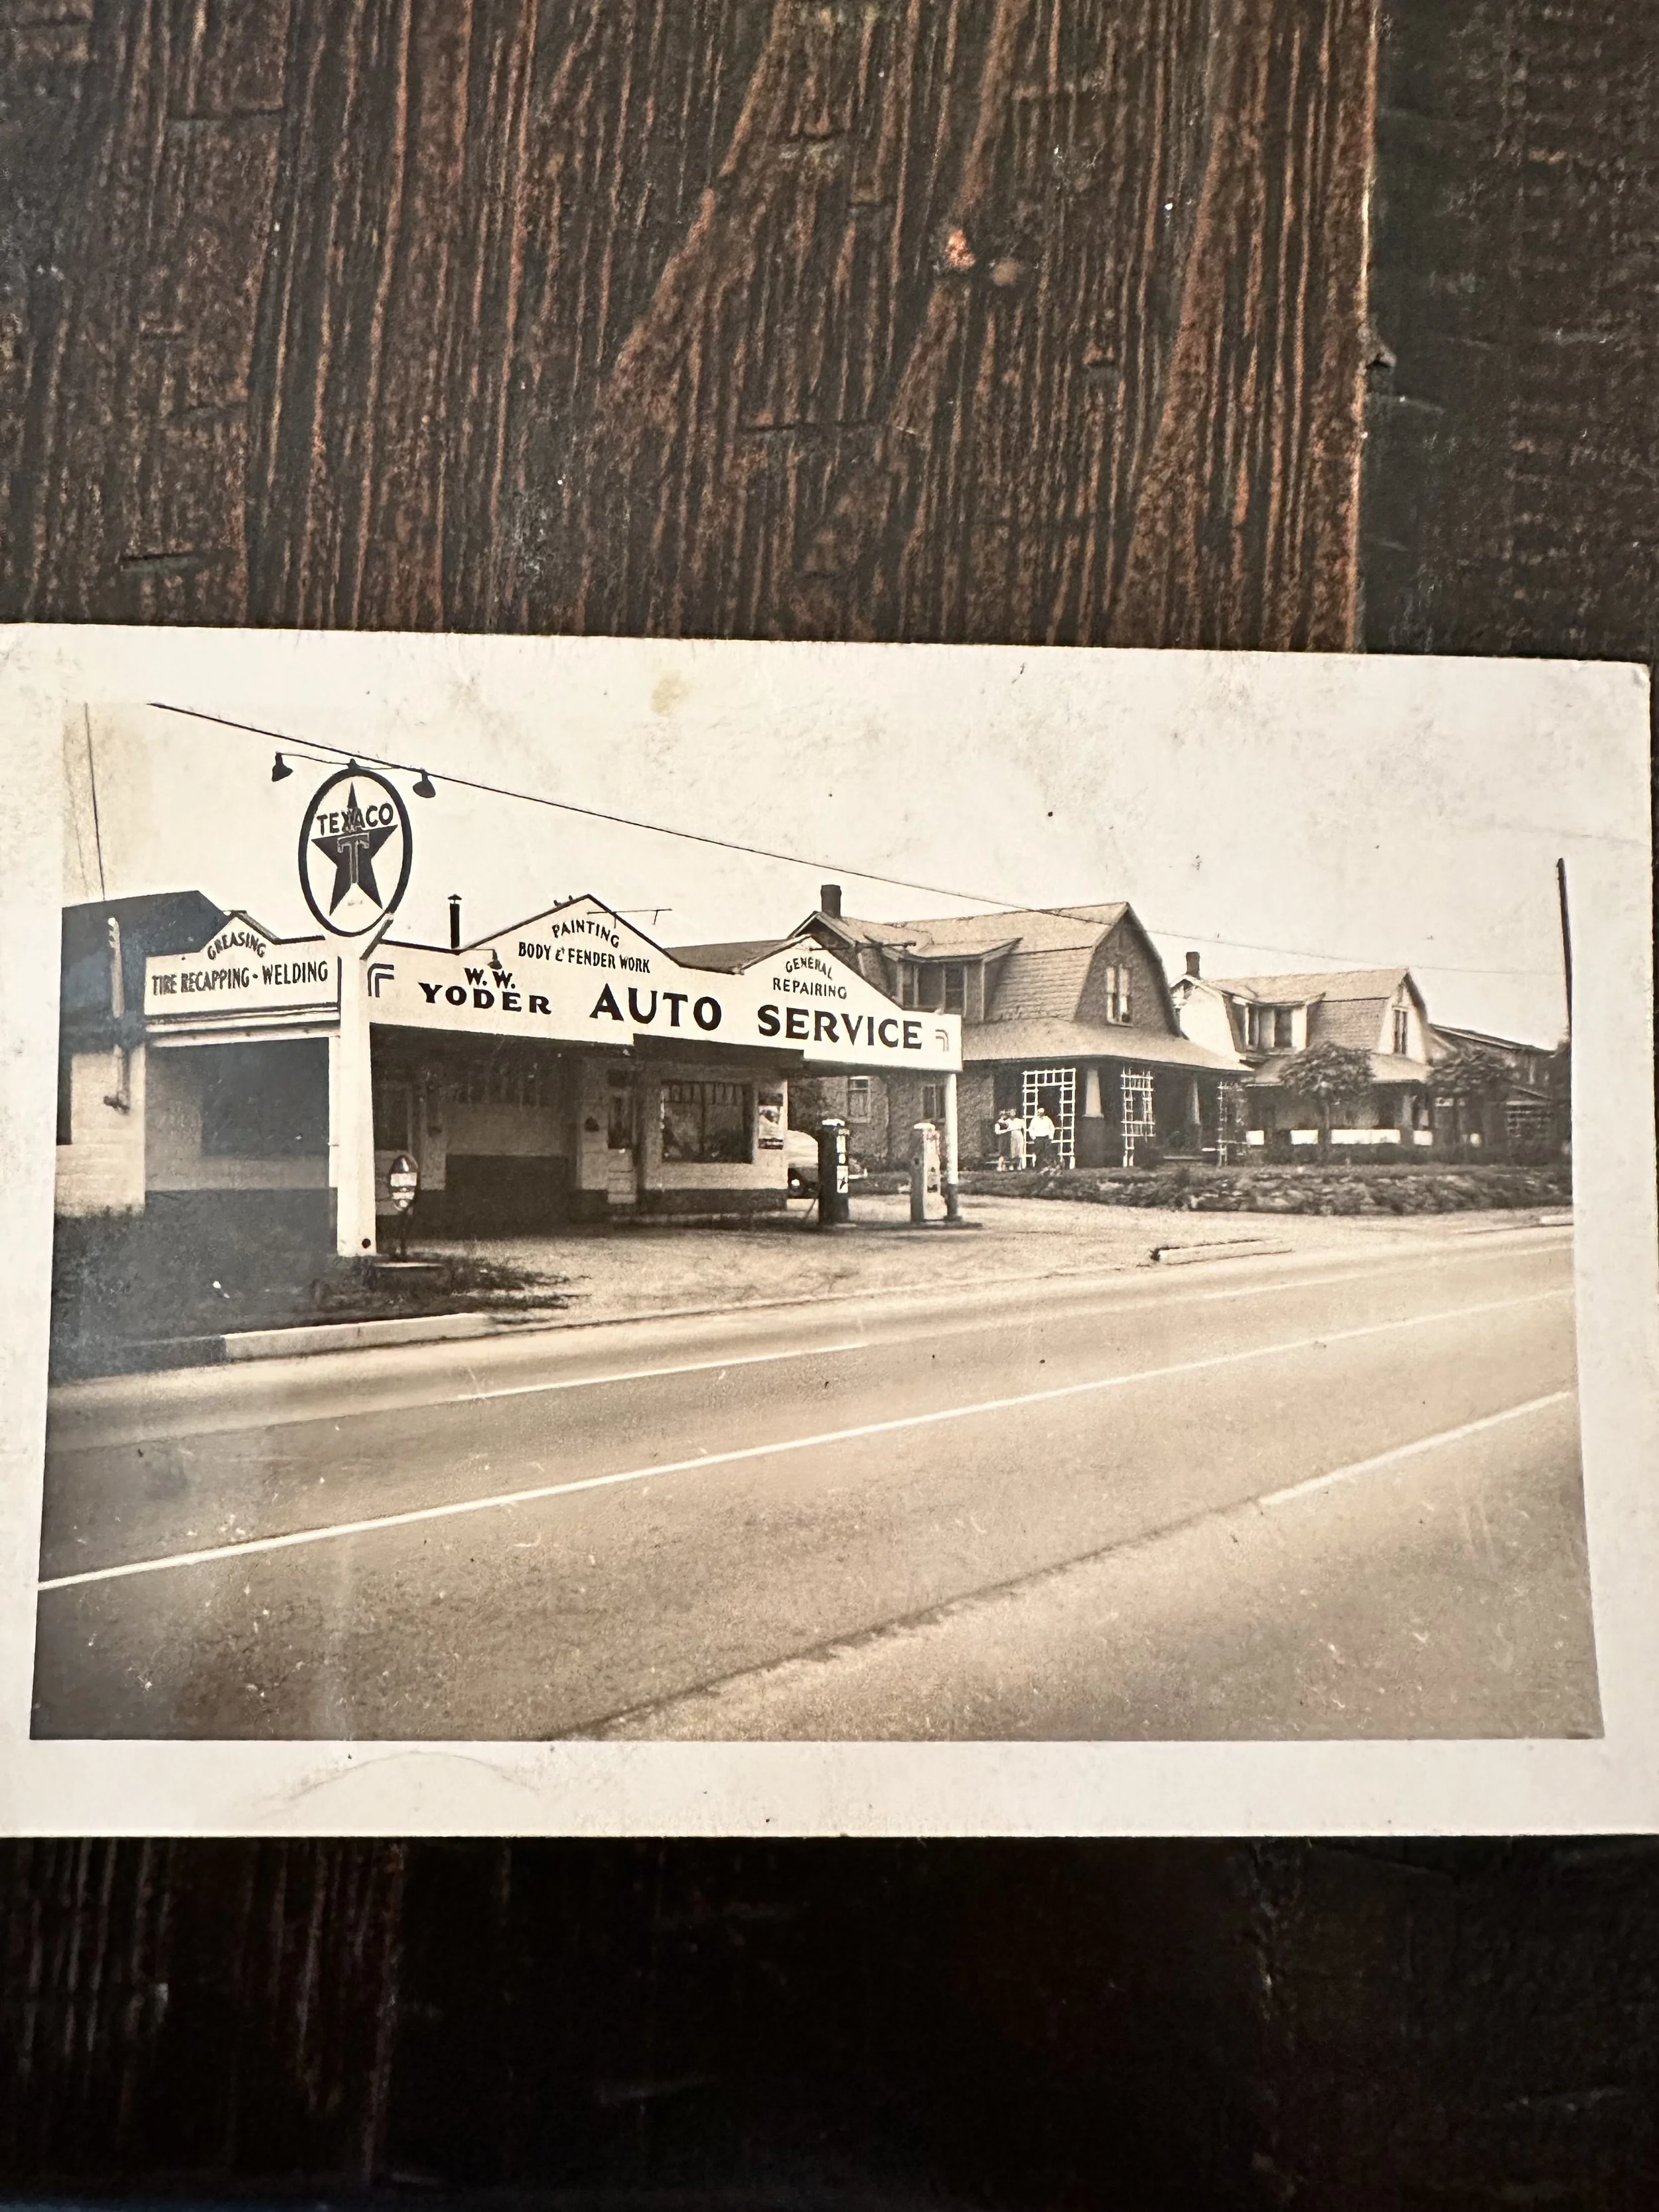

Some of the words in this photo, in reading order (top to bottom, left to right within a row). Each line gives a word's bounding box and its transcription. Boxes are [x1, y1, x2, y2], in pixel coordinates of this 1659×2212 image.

[316, 802, 394, 836] TEXACO
[207, 931, 267, 961] GREASING
[551, 919, 620, 949] PAINTING
[518, 941, 551, 961] BODY
[568, 948, 616, 970] FENDER
[618, 954, 650, 974] WORK
[785, 956, 833, 980] GENERAL
[151, 974, 178, 996] TIRE
[180, 967, 250, 994] RECAPPING
[261, 960, 328, 986] WELDING
[772, 976, 847, 1000] REPAIRING
[417, 982, 552, 1015] YODER
[589, 982, 723, 1031] AUTO
[757, 1003, 923, 1050] SERVICE
